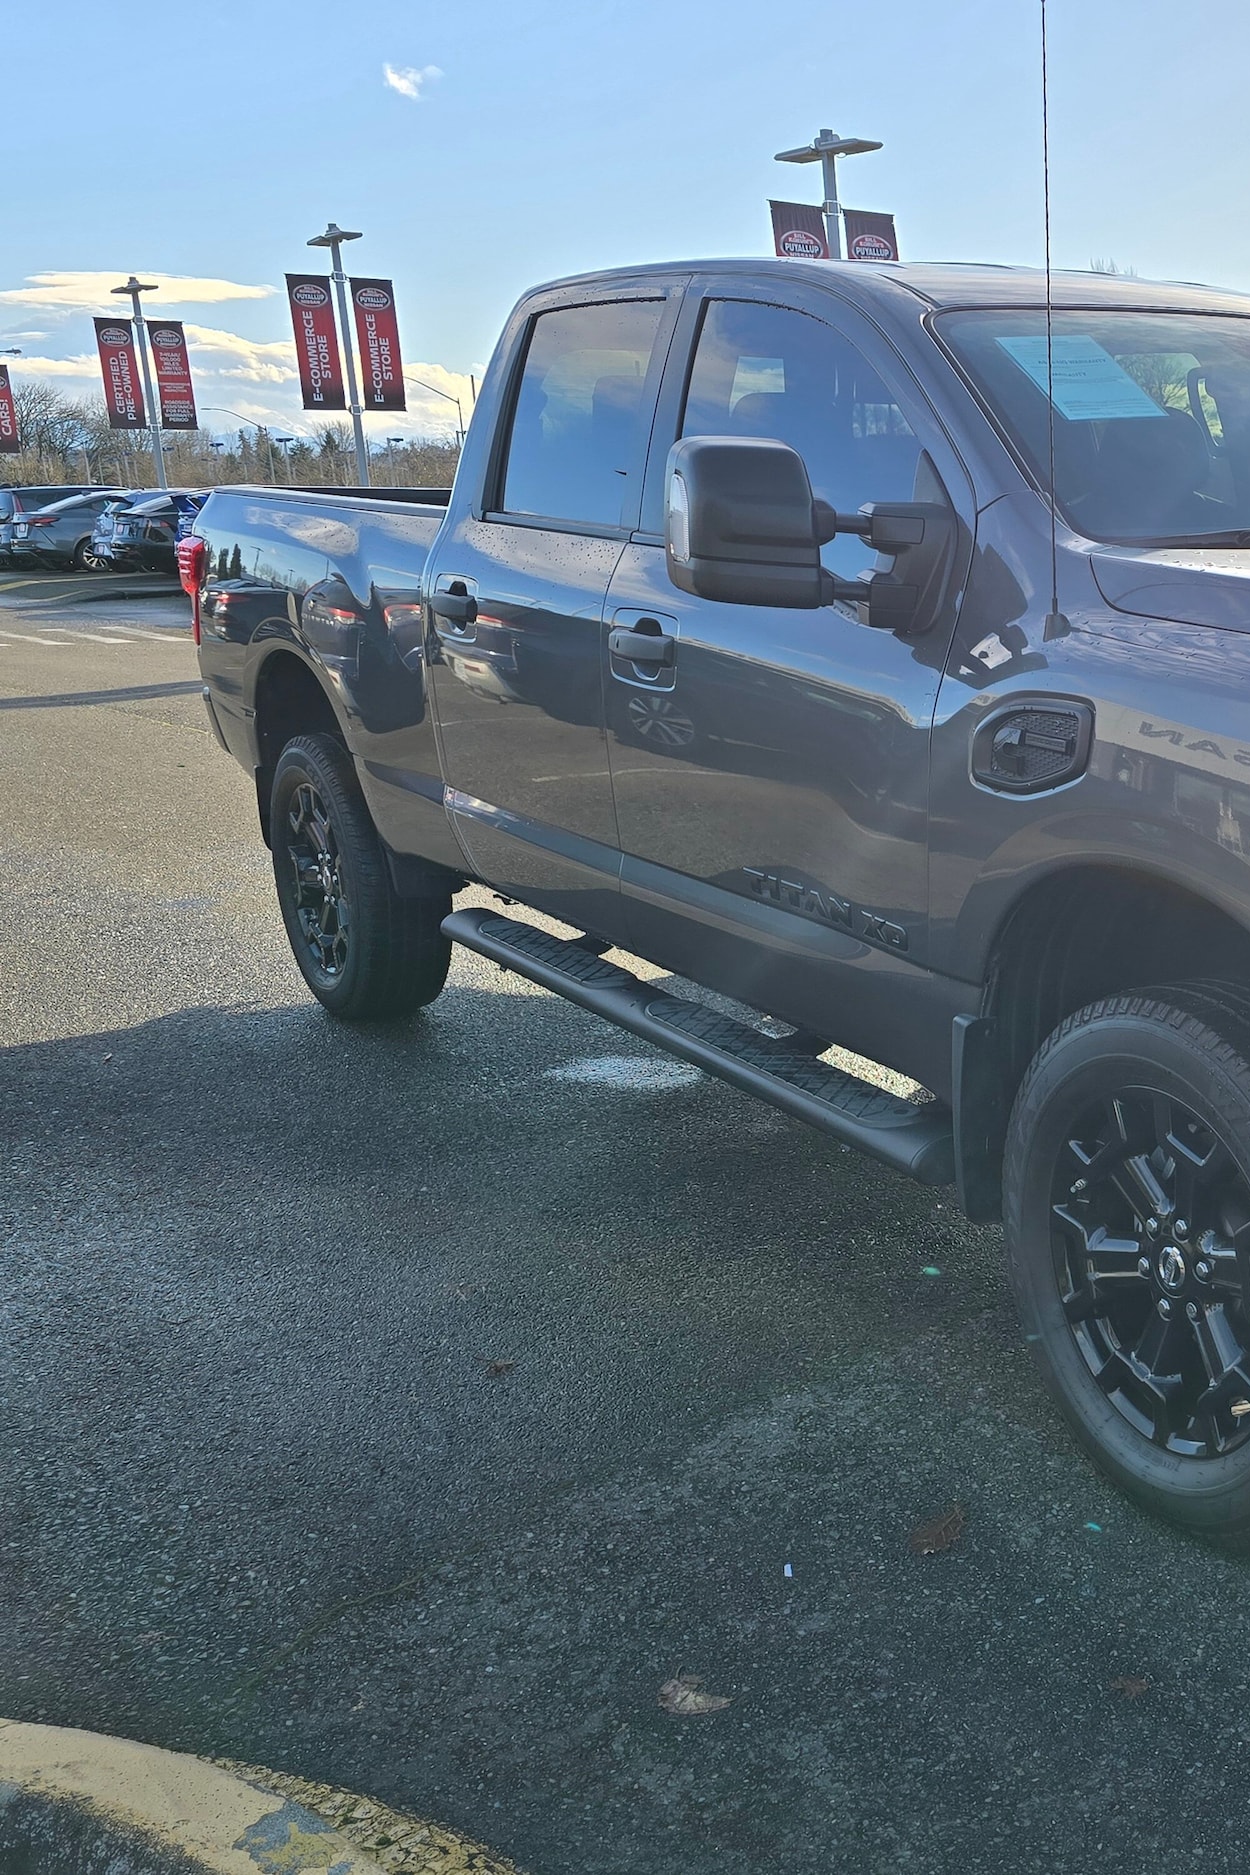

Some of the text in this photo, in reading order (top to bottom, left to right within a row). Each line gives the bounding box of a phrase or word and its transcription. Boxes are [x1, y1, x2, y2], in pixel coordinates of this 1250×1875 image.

[784, 243, 819, 254] PUYALLUP
[855, 247, 889, 257] PUYALLUP
[109, 356, 126, 414] CERTIFIED
[118, 350, 137, 420] PRE-OWNED
[302, 310, 324, 402] E-COMMERCE
[317, 335, 332, 379] STORE
[365, 313, 385, 403] E-COMMERCE
[379, 337, 393, 381] STORE
[742, 866, 853, 929] TITAN
